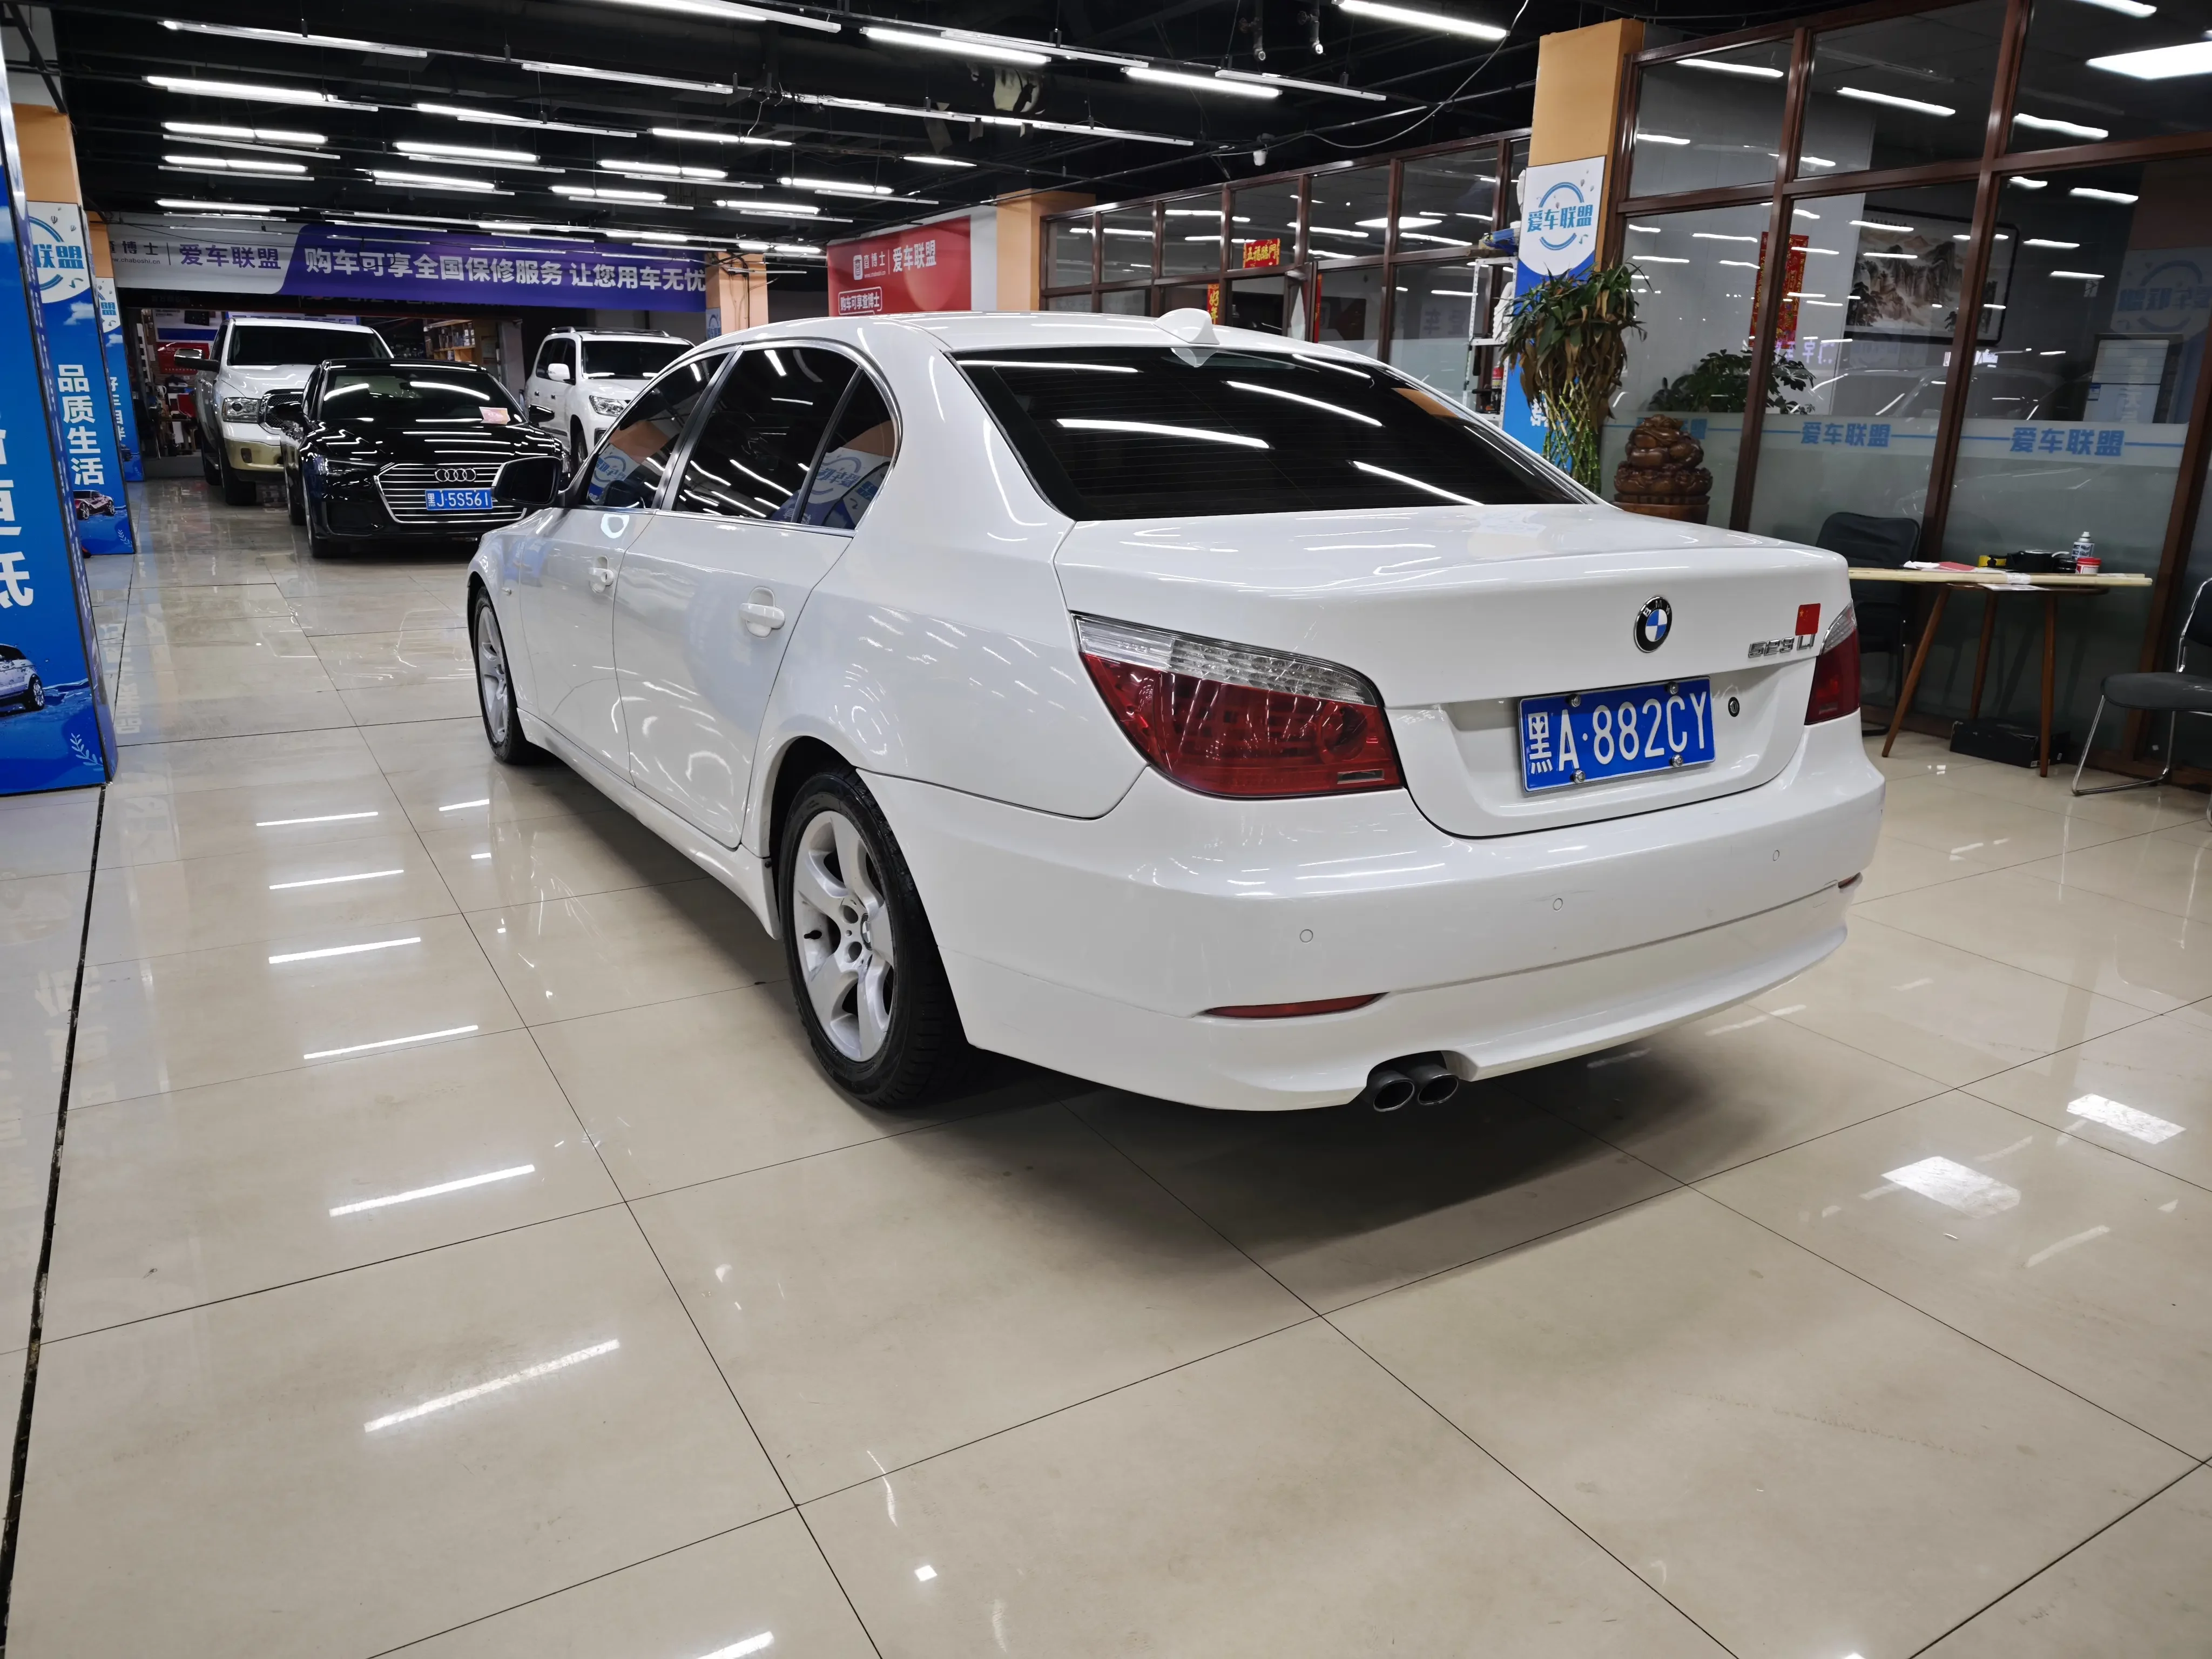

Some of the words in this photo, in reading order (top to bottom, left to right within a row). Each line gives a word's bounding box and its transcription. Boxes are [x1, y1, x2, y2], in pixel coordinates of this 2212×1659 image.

[1527, 205, 1593, 232] 爱车联盟
[179, 244, 281, 269] 爱车联盟
[305, 247, 563, 286] 购车可享全国保修服务
[570, 262, 706, 292] 让您用车无忧
[893, 240, 937, 272] 爱车联盟
[58, 364, 104, 485] 品质生活
[1800, 422, 1891, 448] 爱车联盟
[2009, 427, 2125, 457] 爱车联盟
